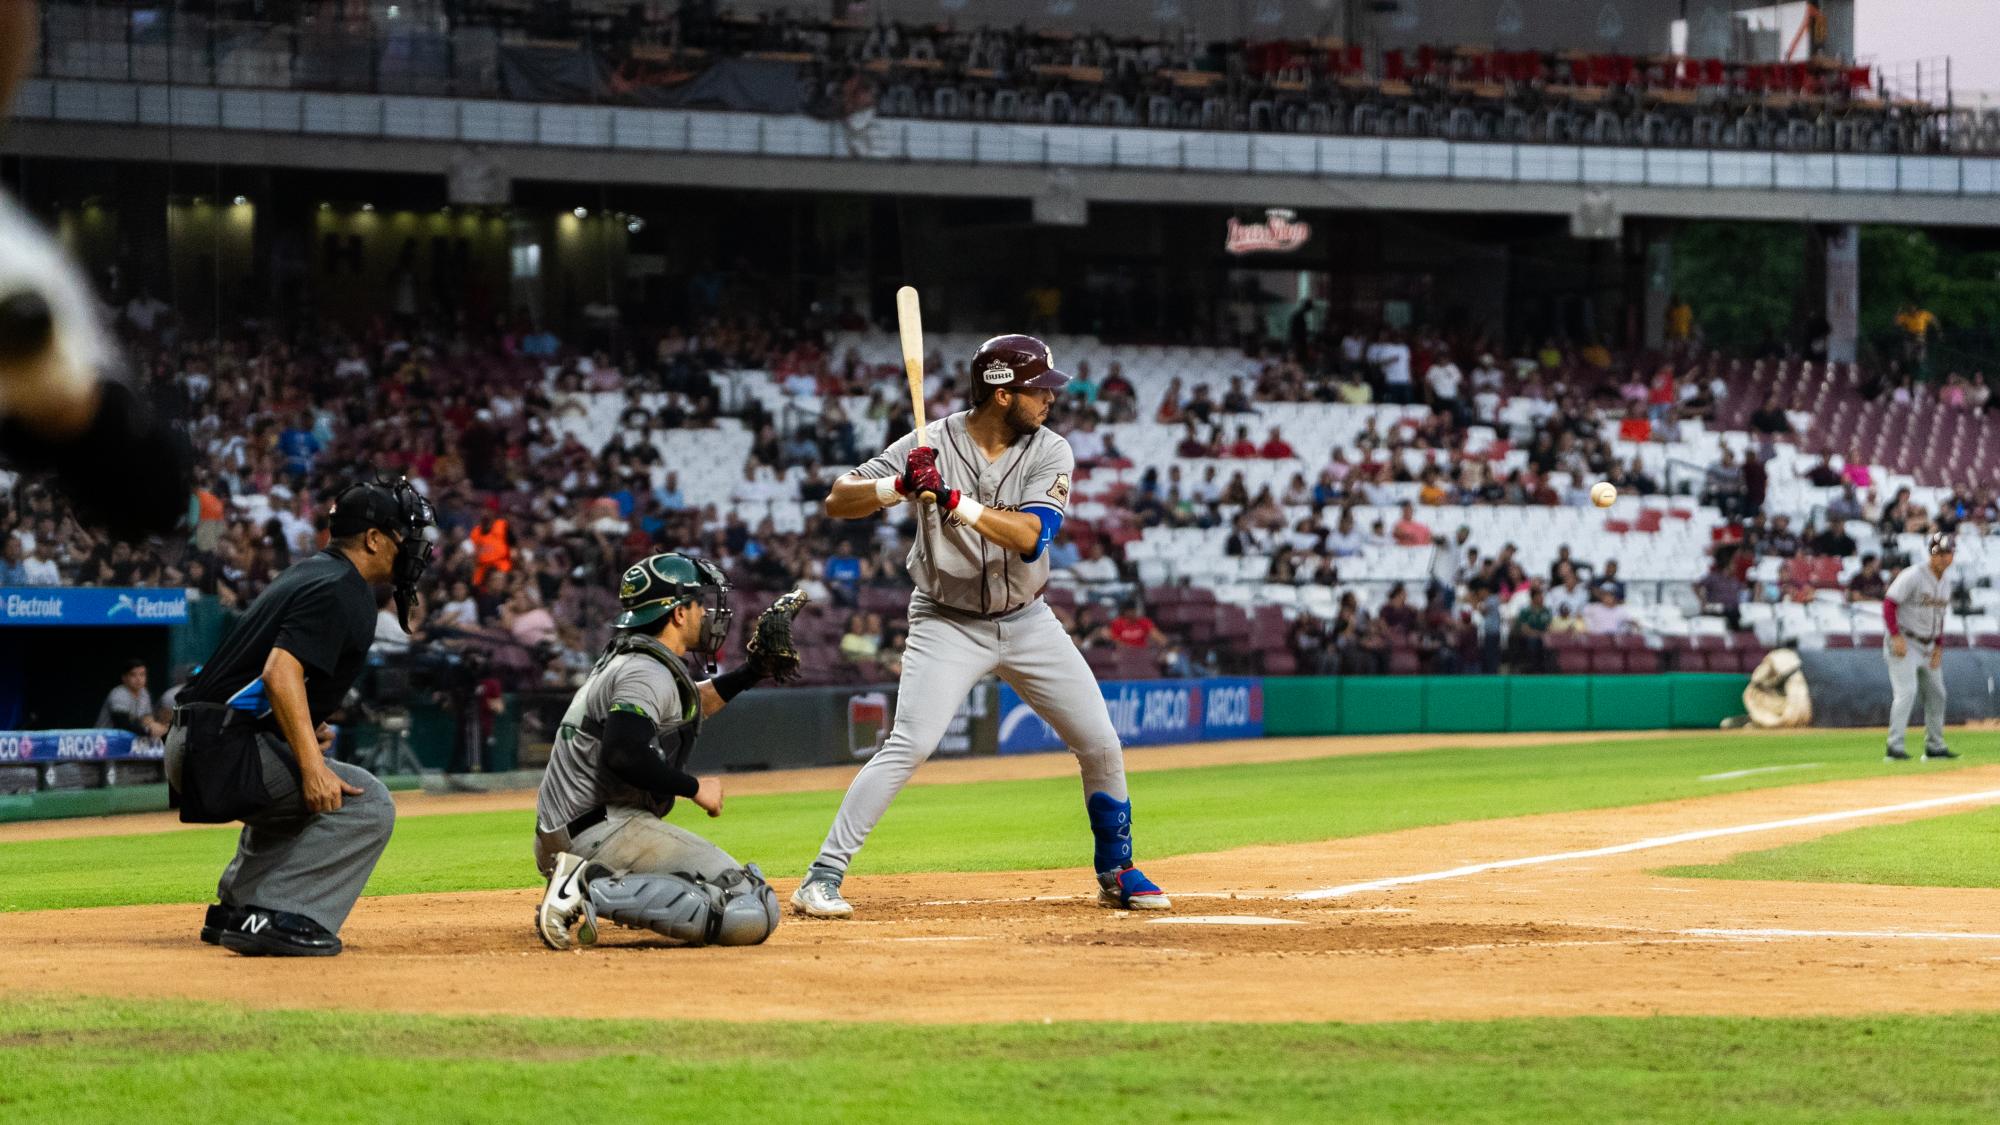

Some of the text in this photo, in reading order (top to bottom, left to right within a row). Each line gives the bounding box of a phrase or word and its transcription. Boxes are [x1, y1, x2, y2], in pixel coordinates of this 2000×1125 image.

[7, 593, 63, 617] Electrolit
[1143, 689, 1188, 729] ARCO
[1207, 686, 1250, 726] ARCO
[57, 735, 95, 757] ARCO
